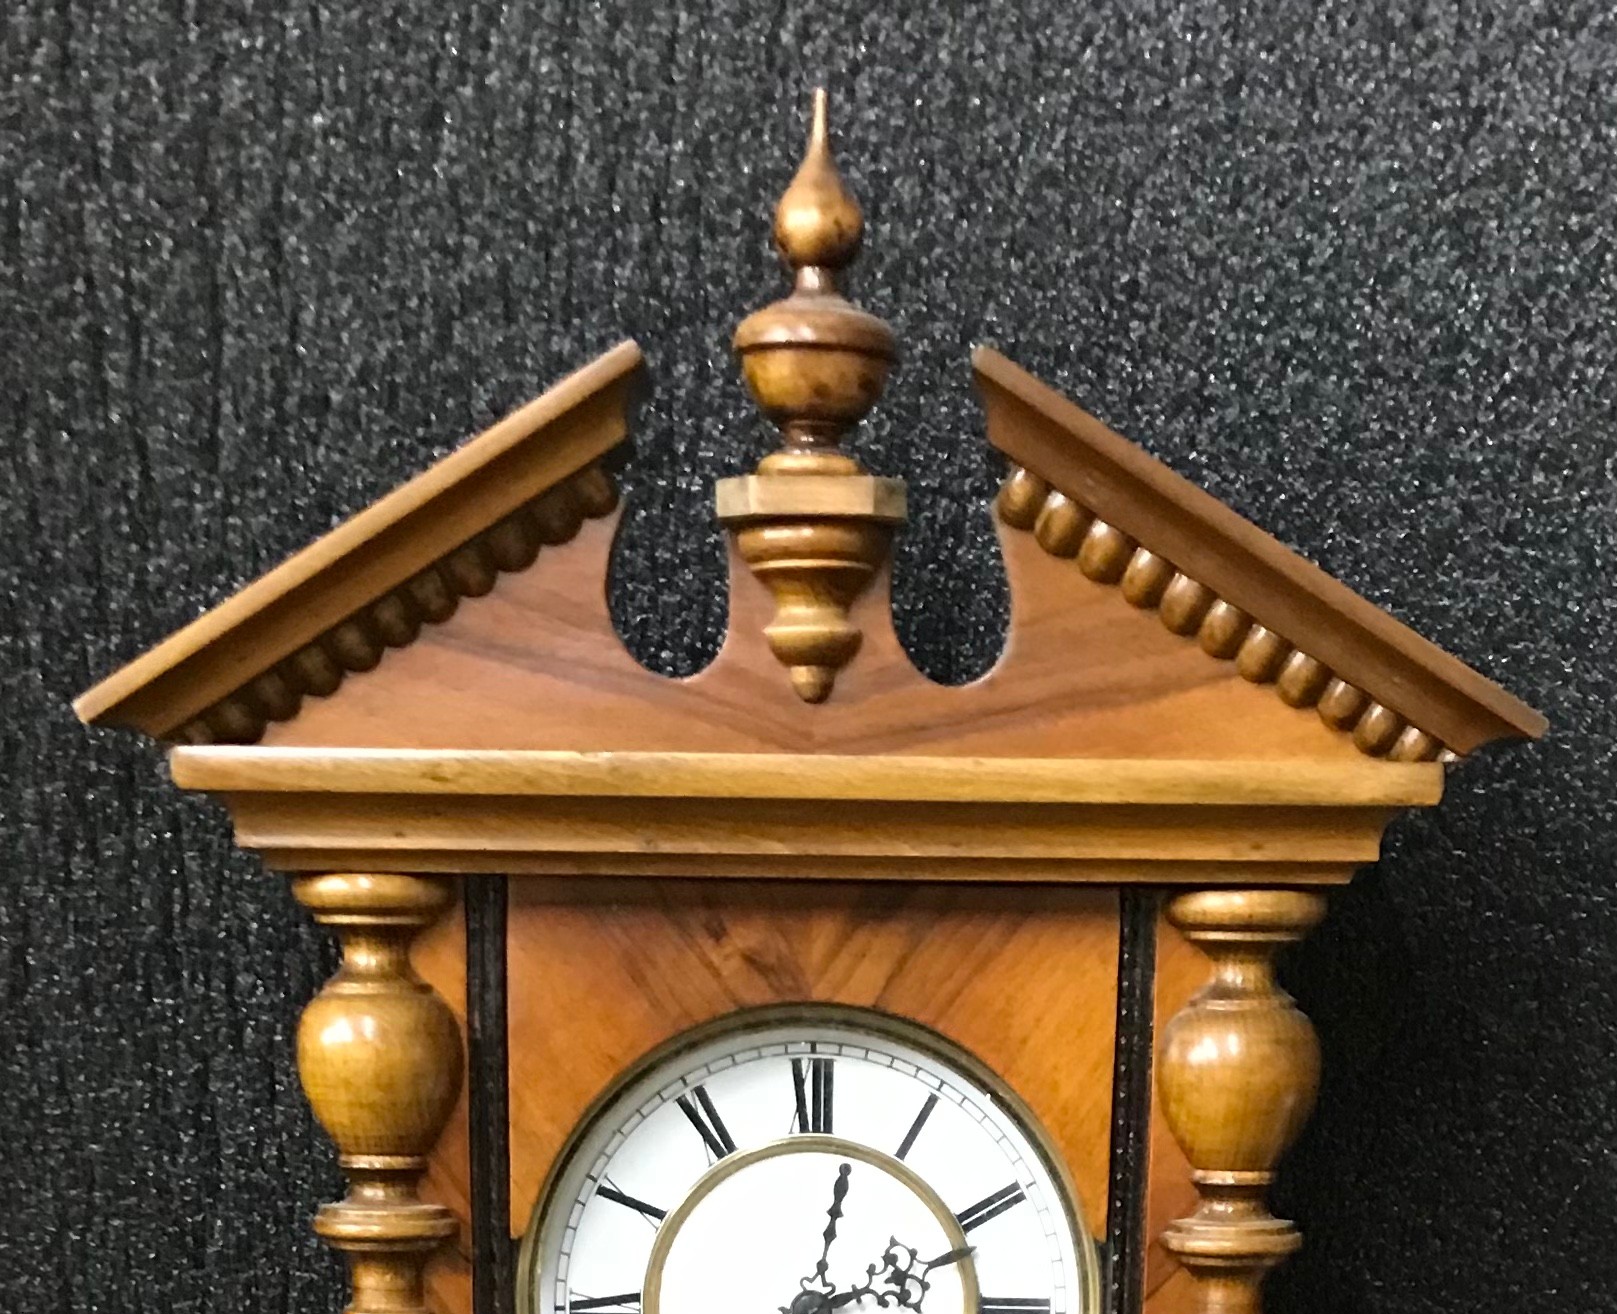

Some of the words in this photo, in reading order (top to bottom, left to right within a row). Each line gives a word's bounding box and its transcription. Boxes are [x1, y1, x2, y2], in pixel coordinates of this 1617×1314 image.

[675, 1084, 736, 1165] XI
[790, 1059, 834, 1134] XII
[895, 1092, 940, 1160] I
[597, 1175, 666, 1230] X
[957, 1181, 1026, 1233] II
